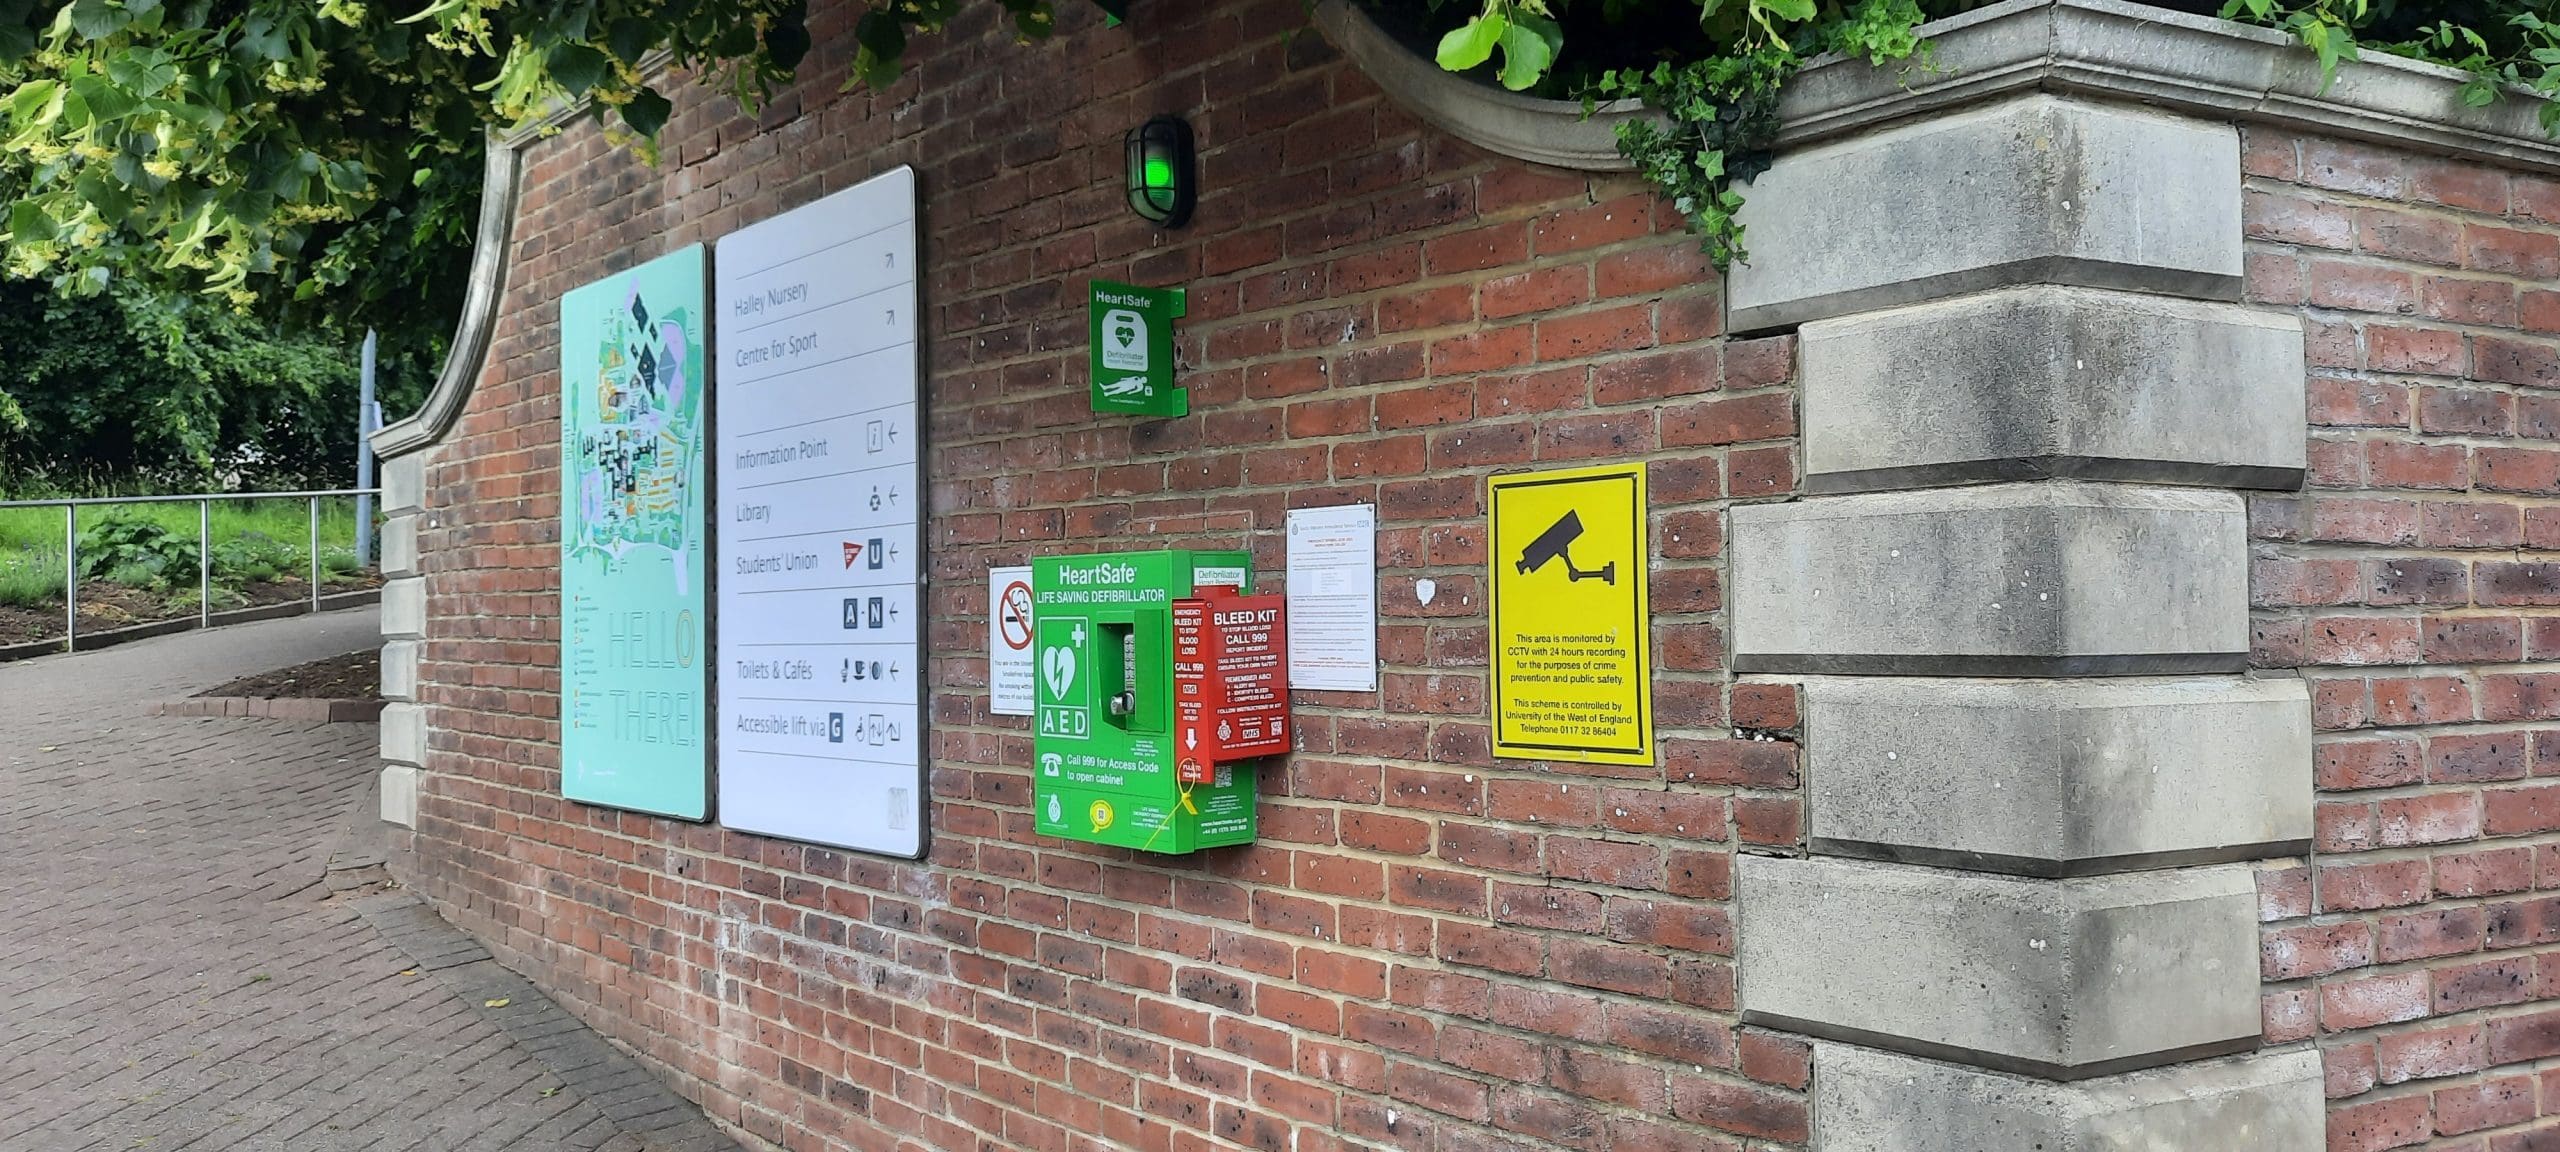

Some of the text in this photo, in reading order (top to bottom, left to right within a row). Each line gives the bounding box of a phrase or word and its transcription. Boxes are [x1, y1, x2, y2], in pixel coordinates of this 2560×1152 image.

[735, 282, 808, 317] Halley Nursery
[736, 332, 818, 367] Centre for Sport
[736, 438, 828, 469] Information Point
[736, 504, 771, 524] Library
[786, 551, 818, 571] Union
[1036, 589, 1165, 604] LIFE SAVING DEFIBRILLATOR
[1213, 609, 1277, 626] BLEED KIT
[609, 608, 696, 669] HELLO
[1178, 636, 1199, 645] BLOOD
[1225, 633, 1268, 645] CALL 999
[1516, 634, 1532, 643] This
[1553, 634, 1560, 643] is
[1561, 634, 1603, 643] monitored
[1605, 634, 1615, 644] by
[1181, 647, 1197, 655] LOSS
[1507, 647, 1626, 658] CCTV with 24 hours recording
[736, 659, 813, 680] Toilets & Cafés
[1175, 662, 1192, 672] CALL
[1516, 660, 1616, 671] for the purposes of crime
[1510, 674, 1624, 685] prevention and public safety.
[1513, 698, 1622, 712] This scheme is controlled by
[609, 690, 696, 747] THERE!
[736, 714, 789, 735] Accessible
[792, 715, 807, 736] lift
[810, 717, 826, 737] via
[1043, 709, 1086, 734] AED
[1505, 711, 1632, 725] University of the West of England
[1520, 724, 1617, 736] Telephone 0117 32 86404
[1066, 754, 1160, 773] Call 999 for Access Code
[1066, 770, 1124, 786] to open cabinet
